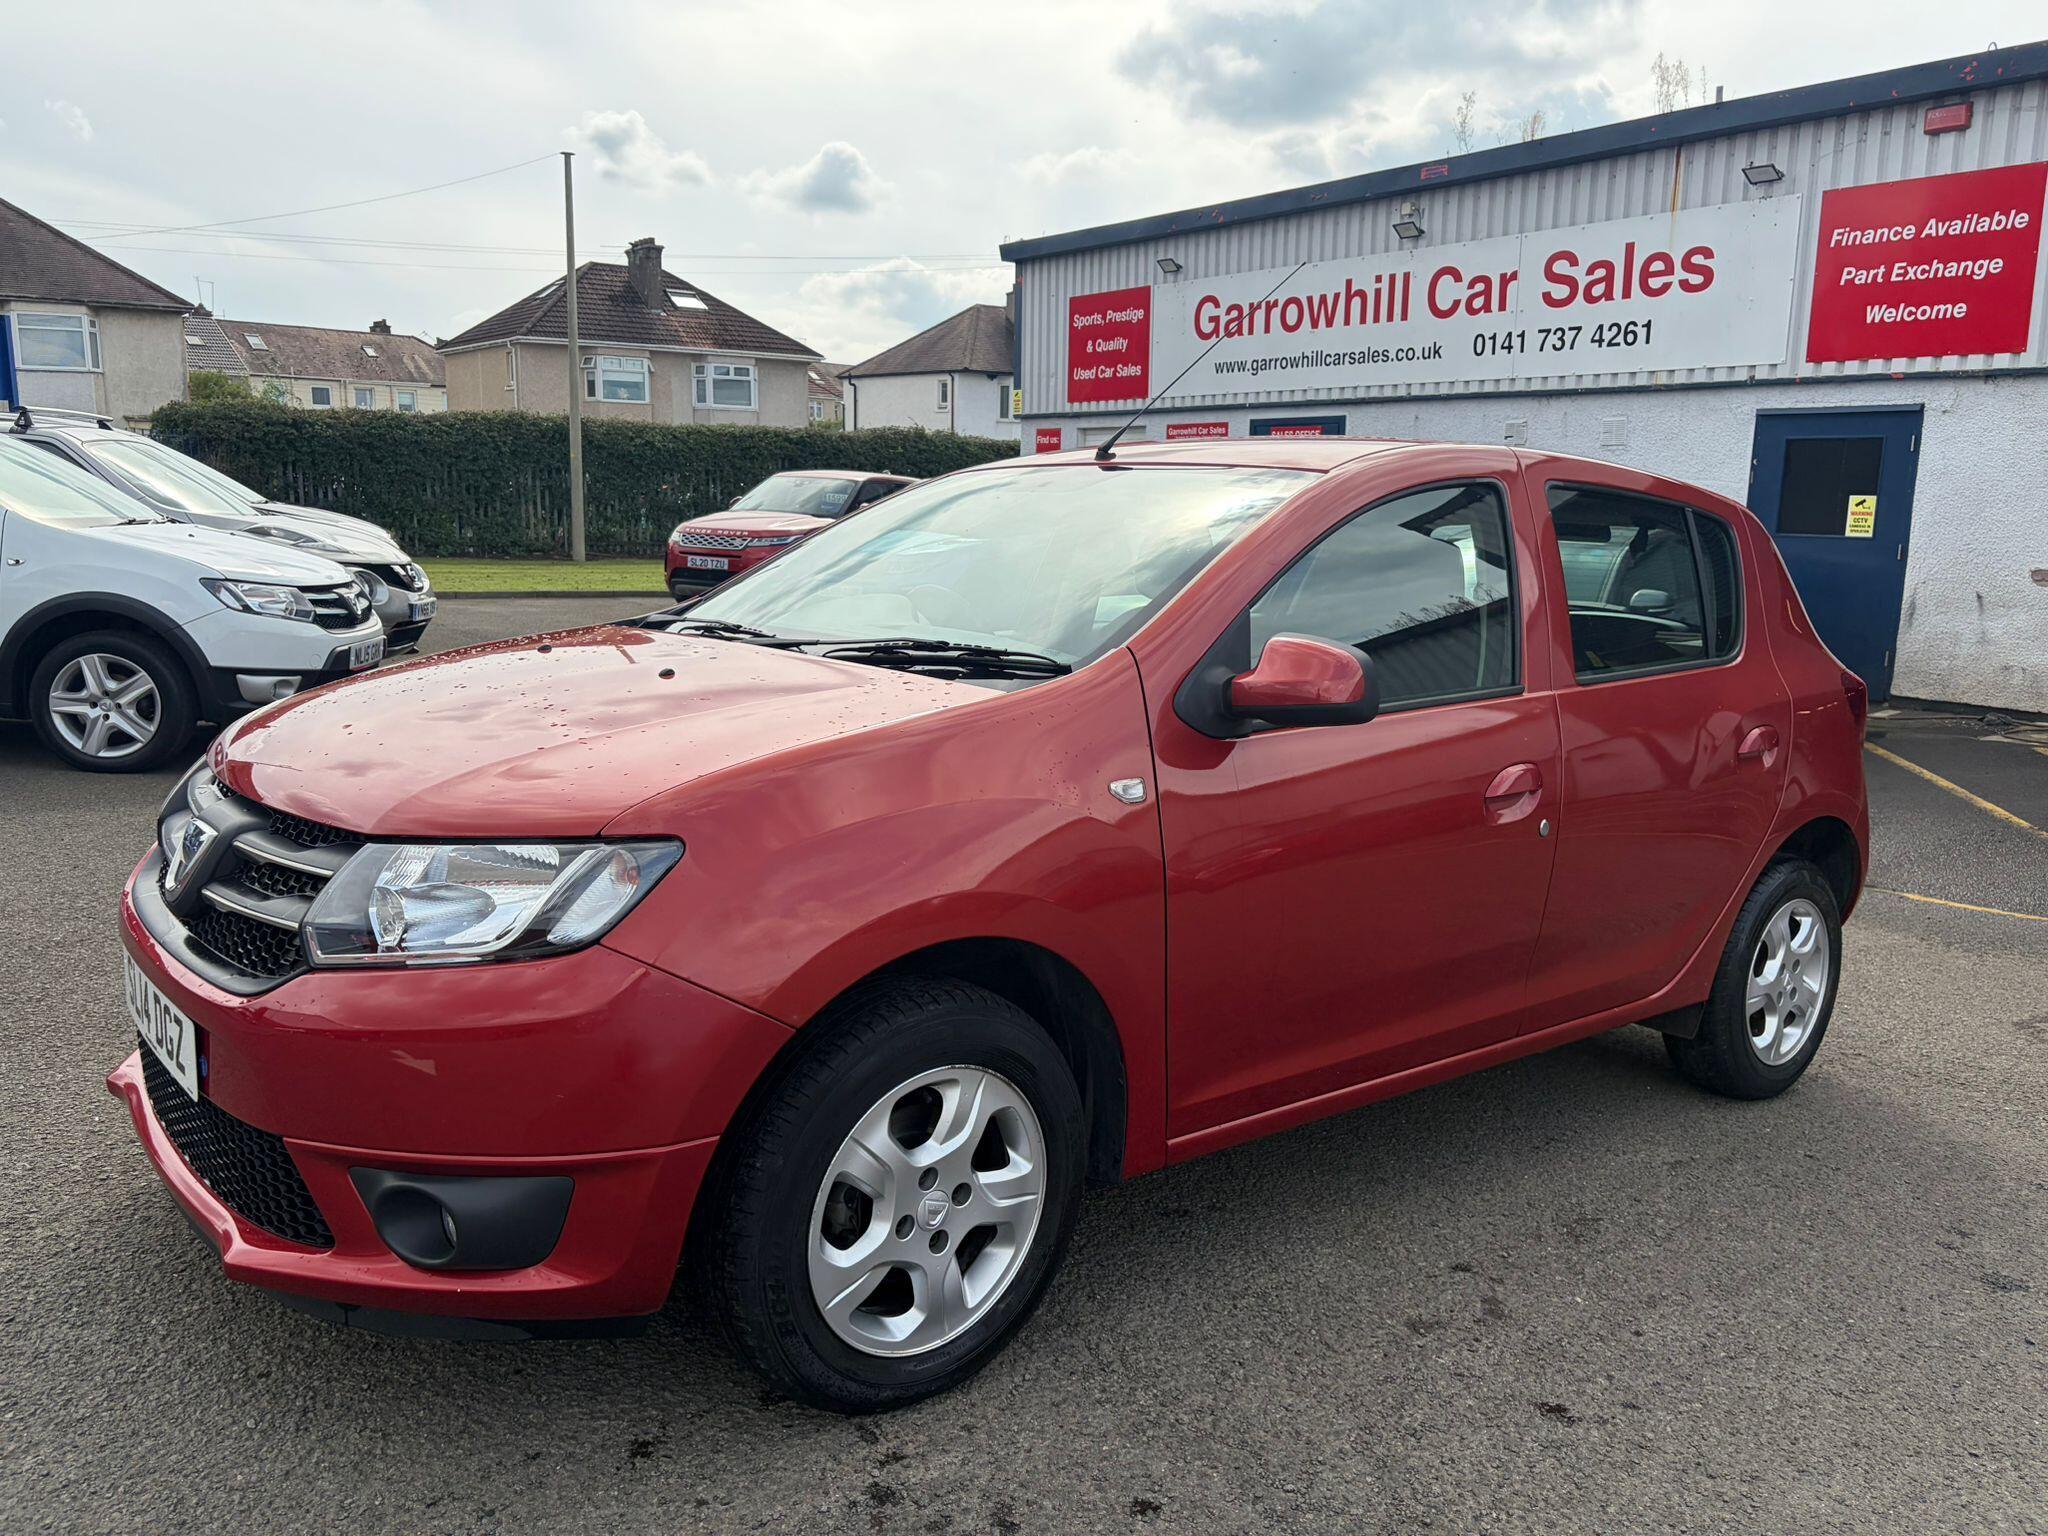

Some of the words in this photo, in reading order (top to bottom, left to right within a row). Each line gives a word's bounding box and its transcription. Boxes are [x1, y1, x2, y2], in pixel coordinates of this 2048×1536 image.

[1830, 223, 1916, 248] Finance
[1921, 209, 2030, 239] Available
[1839, 264, 1886, 286] Part
[1890, 257, 2004, 282] Exchange
[1194, 271, 1412, 341] Garrowhill
[1427, 265, 1518, 320] Car
[1541, 241, 1716, 309] Sales
[1073, 312, 1105, 330] Sports,
[1106, 307, 1145, 324] Prestige
[1865, 302, 1968, 324] Welcome
[1086, 339, 1094, 353] &
[1095, 336, 1129, 353] Quality
[1472, 329, 1527, 357] 0141
[1537, 325, 1583, 353] 737
[1590, 319, 1653, 349] 4261
[1214, 341, 1443, 376] www.garrowhillcarsales.co.uk
[1073, 366, 1097, 380] Used
[1097, 365, 1115, 379] Car
[1116, 363, 1142, 377] Sales
[1036, 435, 1049, 444] Find
[1168, 426, 1197, 436] Garrowhill
[1198, 426, 1209, 435] Car
[1209, 426, 1226, 435] Sales
[690, 557, 709, 568] SL20
[710, 559, 725, 569] TZU
[153, 990, 186, 1077] DGZ
